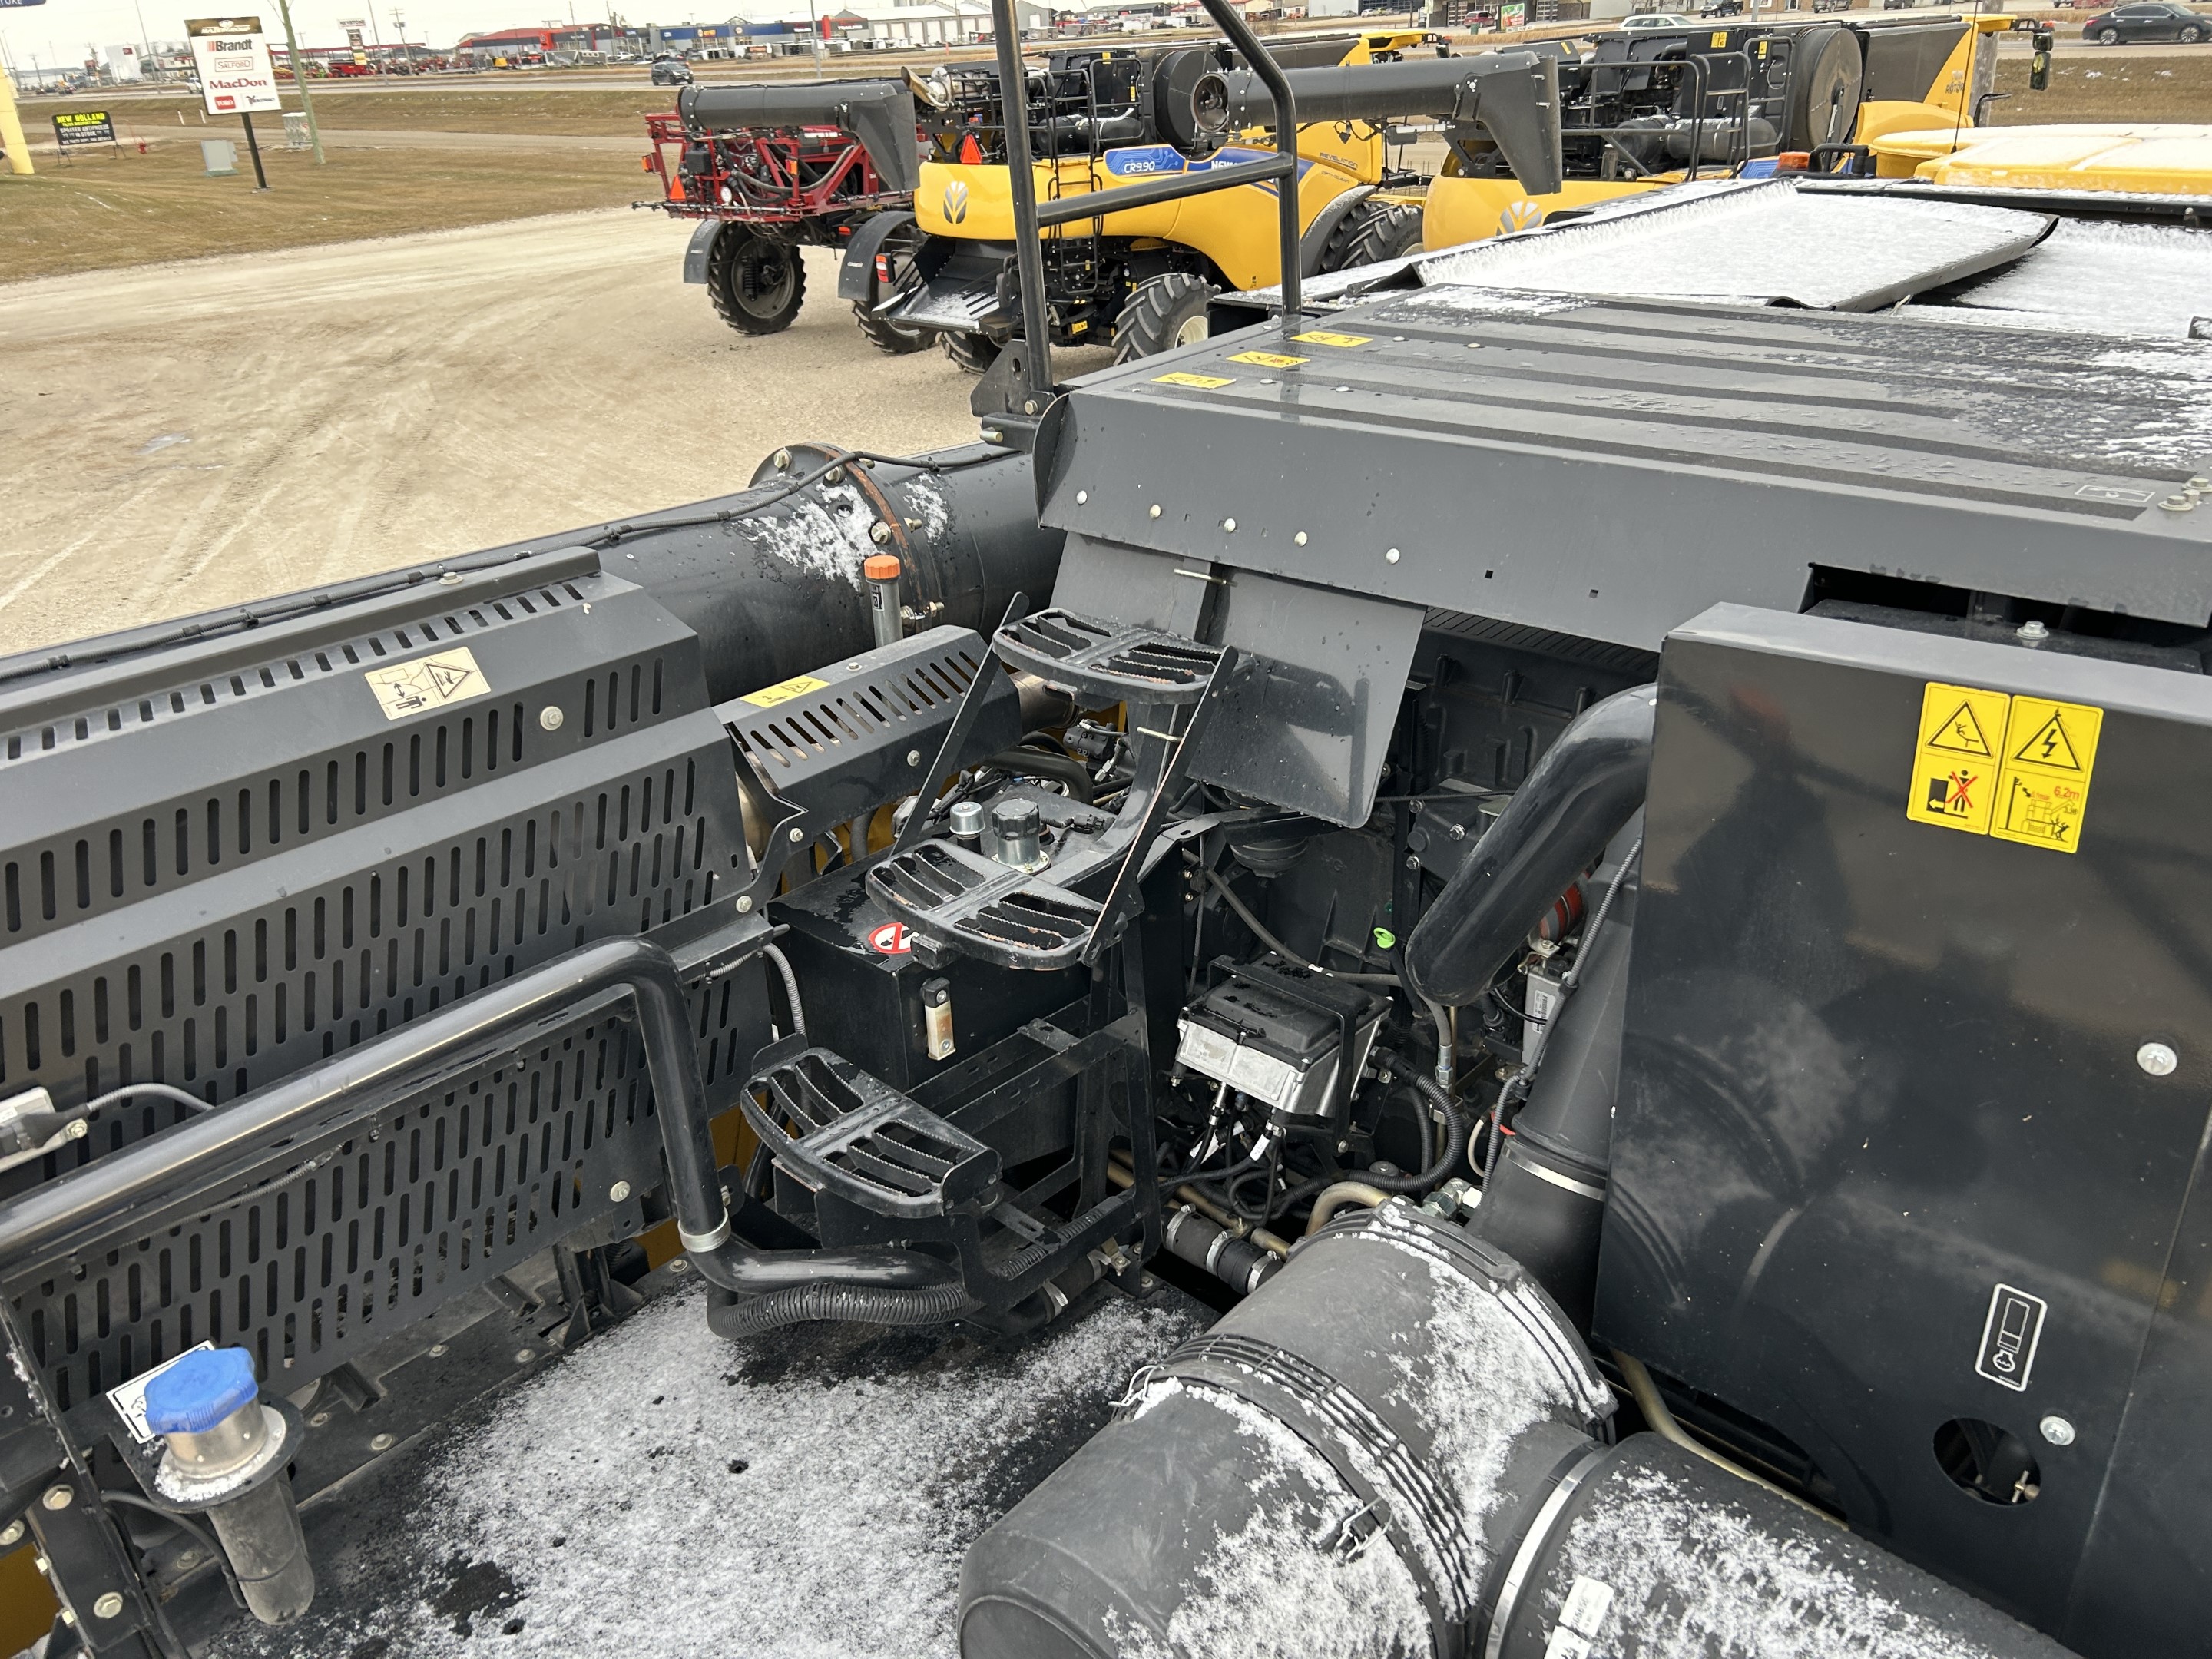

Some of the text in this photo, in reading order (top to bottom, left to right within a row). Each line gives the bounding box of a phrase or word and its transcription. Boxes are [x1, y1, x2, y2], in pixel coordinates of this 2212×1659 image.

[216, 38, 253, 52] Brandt
[217, 60, 251, 69] SALFORD
[209, 78, 267, 90] MacDon
[56, 113, 105, 124] NEW HOLLAND
[1123, 160, 1156, 174] CR9.90
